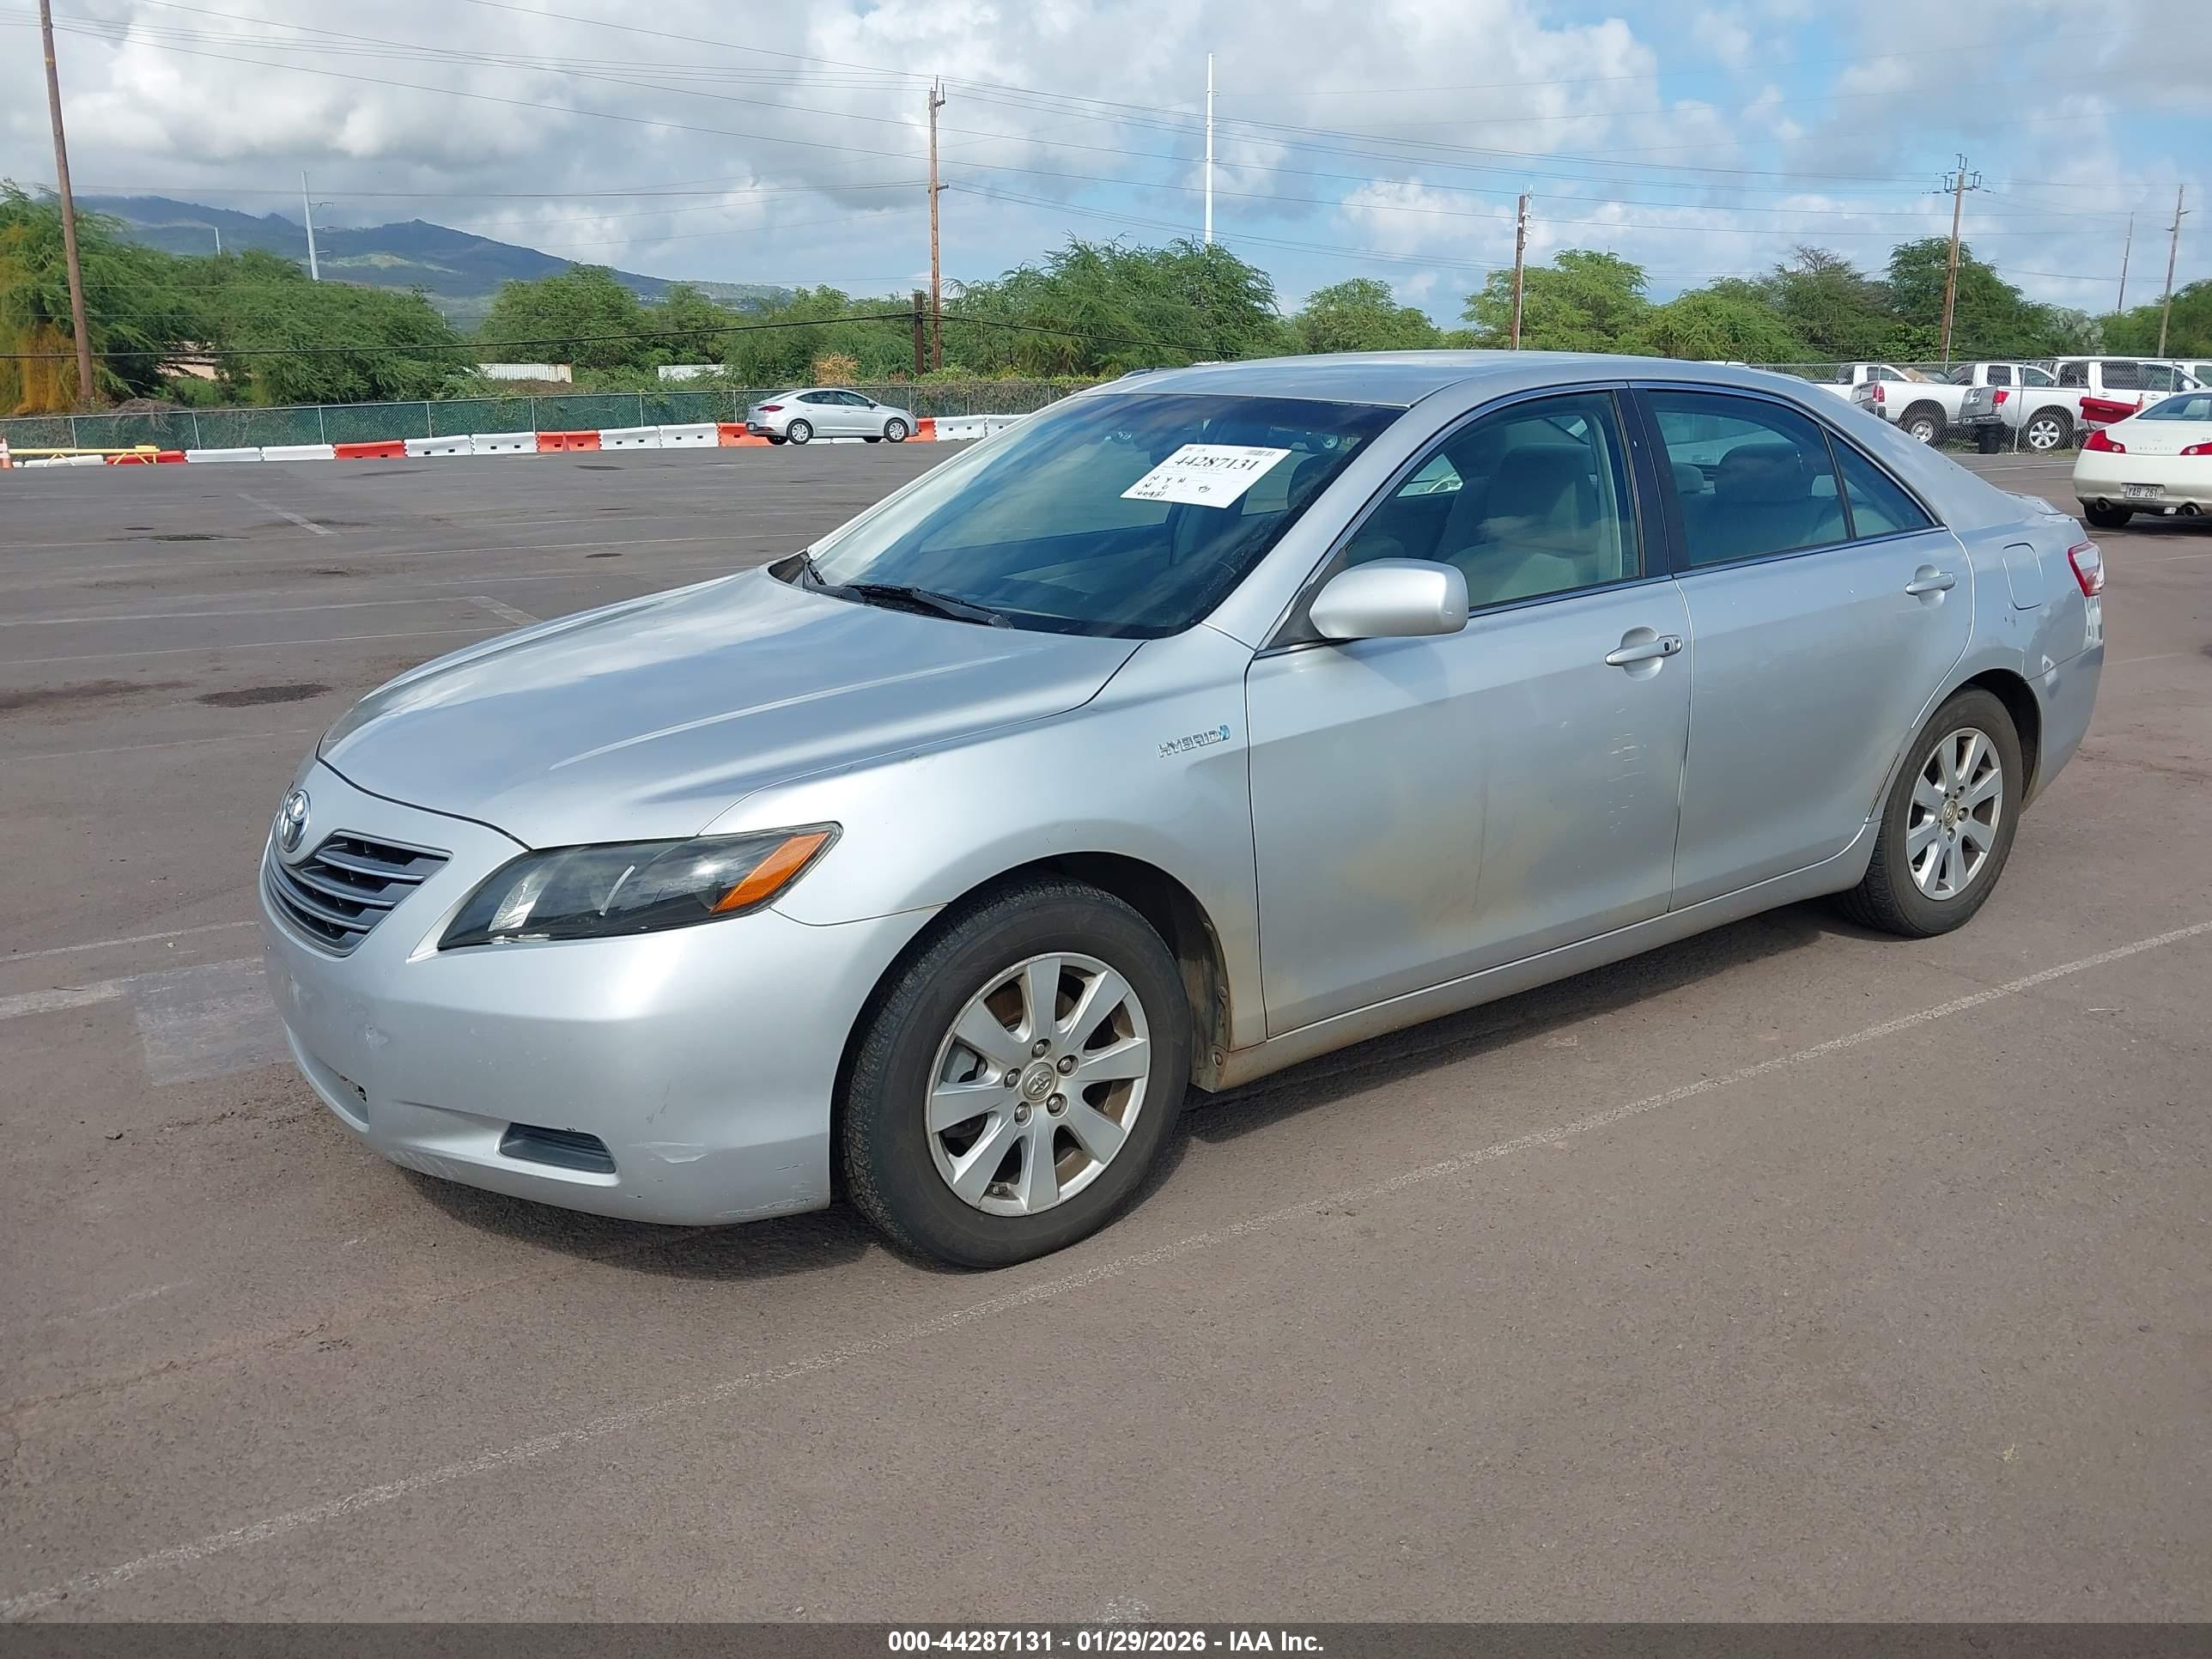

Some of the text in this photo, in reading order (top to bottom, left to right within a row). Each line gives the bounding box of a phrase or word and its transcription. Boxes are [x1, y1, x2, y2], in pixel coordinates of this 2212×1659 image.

[1175, 455, 1260, 471] 44287131
[2144, 488, 2158, 497] 261
[1156, 730, 1219, 757] HYBRID
